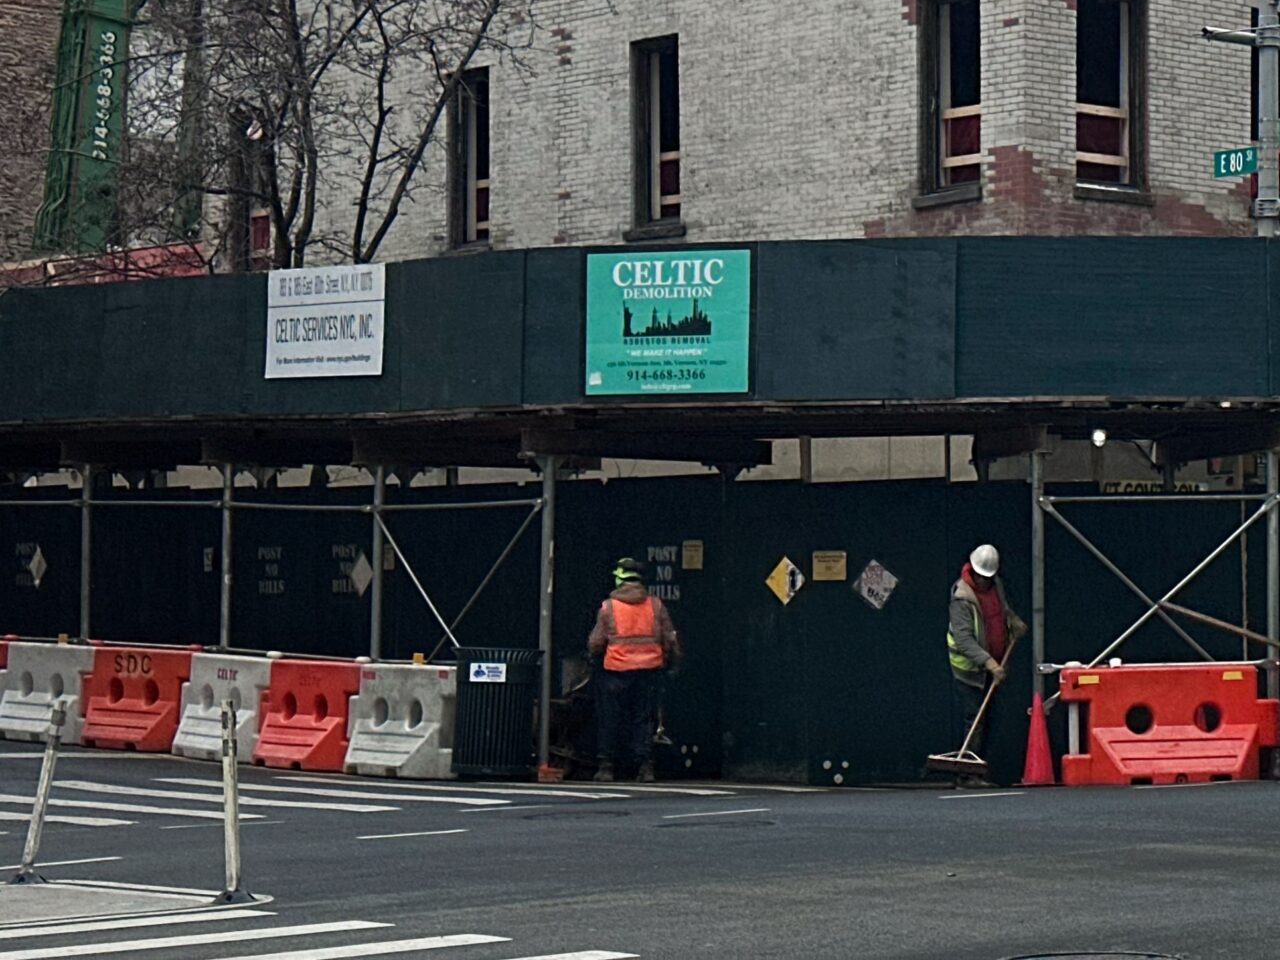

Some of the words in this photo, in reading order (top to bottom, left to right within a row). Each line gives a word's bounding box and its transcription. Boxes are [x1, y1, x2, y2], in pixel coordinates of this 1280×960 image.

[1220, 154, 1227, 173] E
[1229, 151, 1243, 172] 80
[612, 258, 724, 287] CELTIC
[623, 286, 713, 300] DEMOLITION
[275, 317, 301, 343] CELTIC
[302, 315, 339, 342] SERVICES
[340, 314, 357, 342] NYC,
[359, 313, 375, 339] INC.
[671, 336, 711, 344] REMOVAL
[627, 369, 706, 381] 914-668-3366
[257, 545, 283, 560] POST
[331, 543, 358, 559] POST
[646, 545, 679, 563] POST
[265, 563, 279, 577] NO
[656, 565, 673, 581] NO
[258, 578, 286, 595] BILLS
[114, 654, 152, 675] SDC
[217, 667, 239, 681] CELTIC
